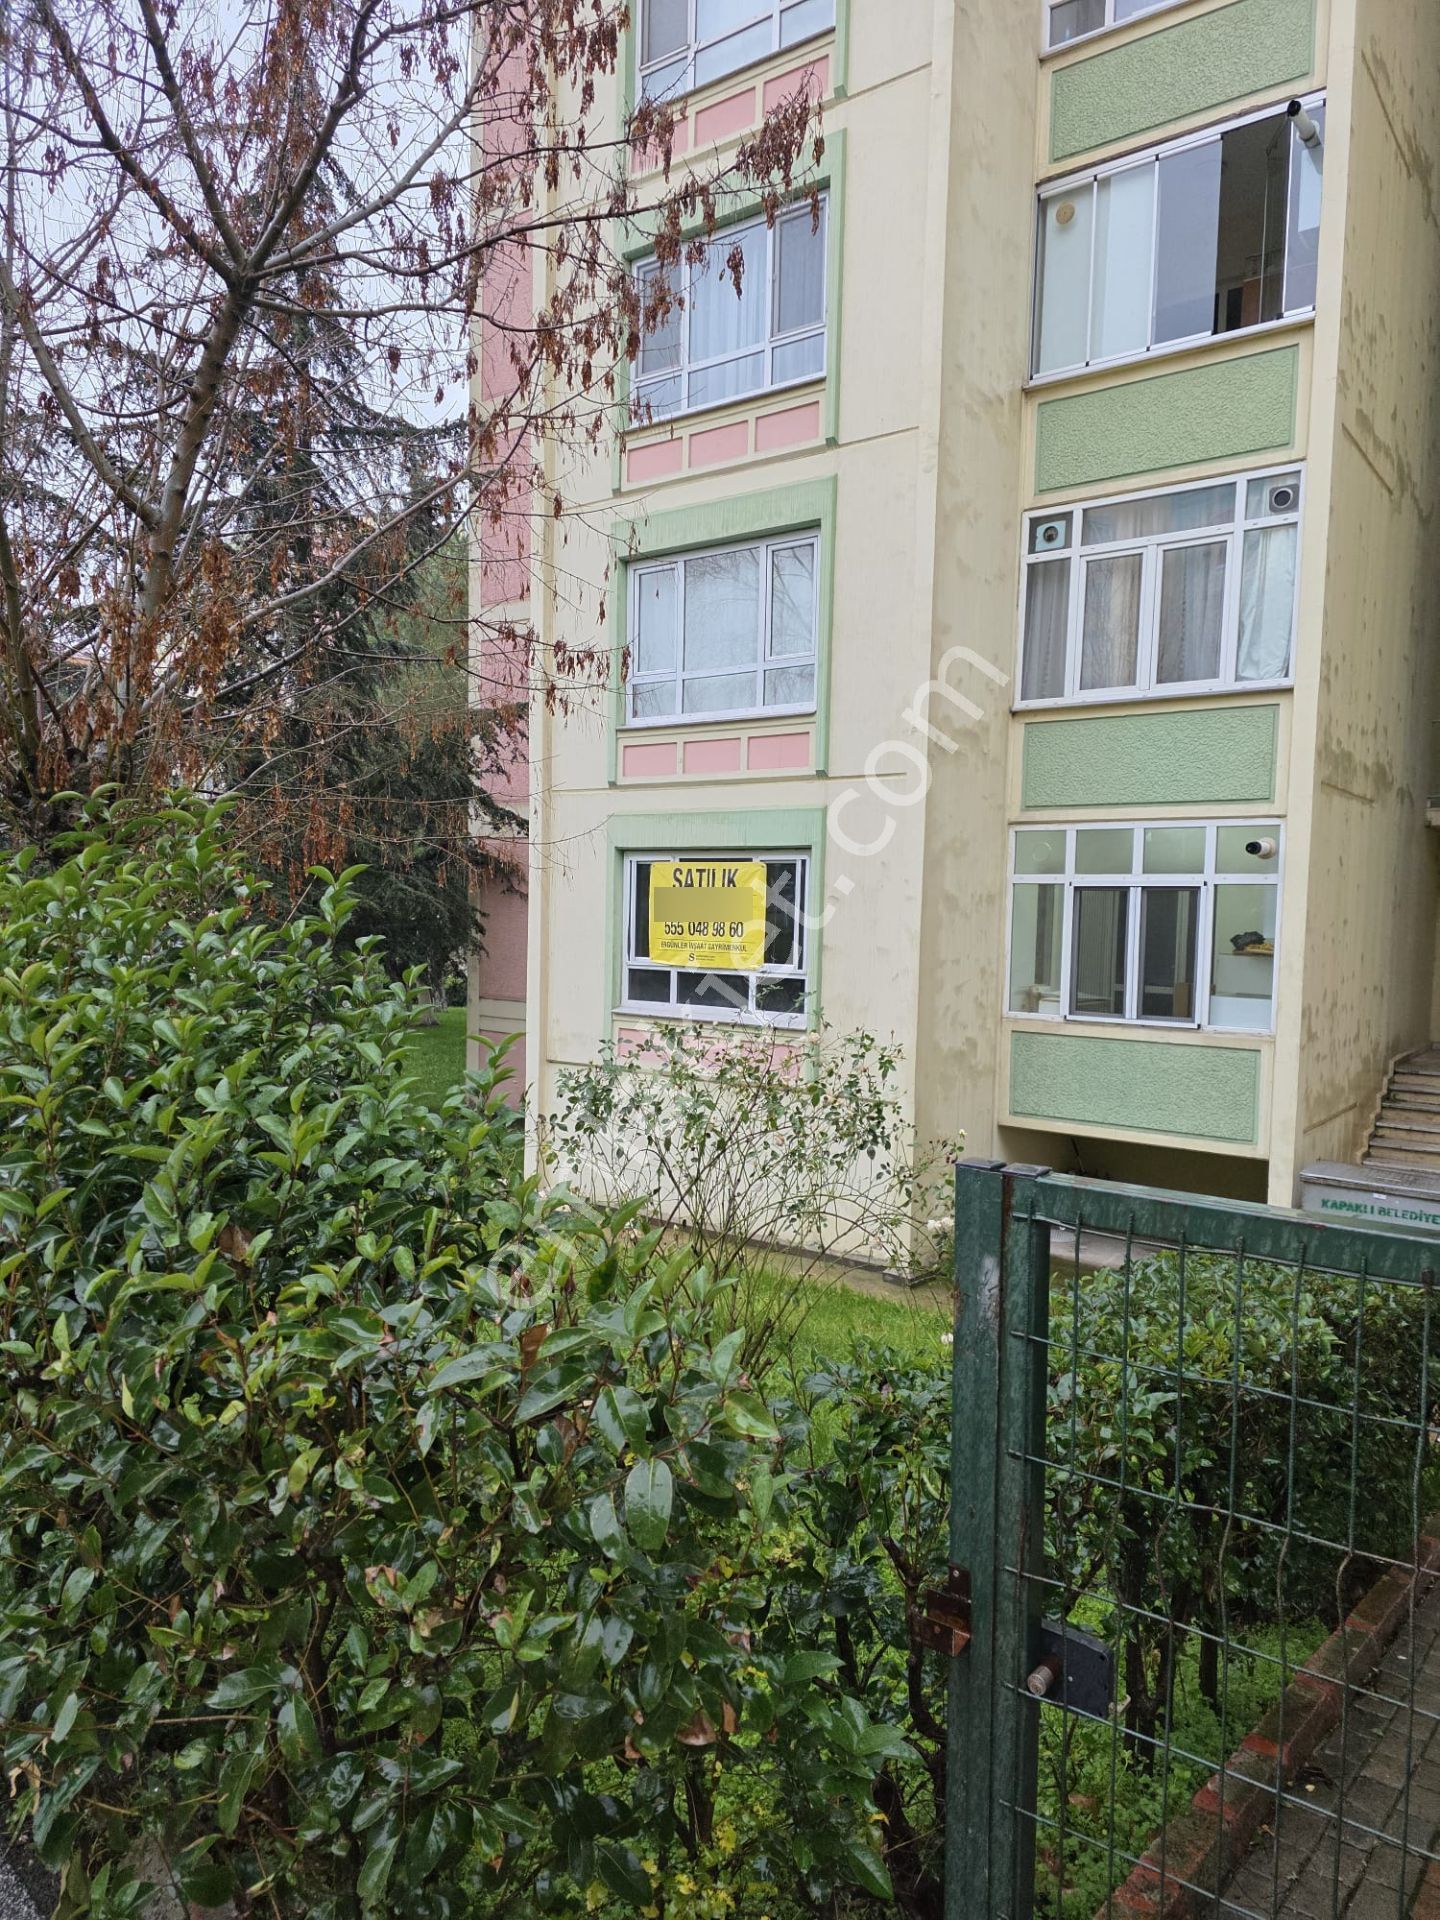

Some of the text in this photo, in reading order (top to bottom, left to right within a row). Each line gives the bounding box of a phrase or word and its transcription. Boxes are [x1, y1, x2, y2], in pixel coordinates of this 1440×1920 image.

[664, 921, 744, 938] 555 048 98 60
